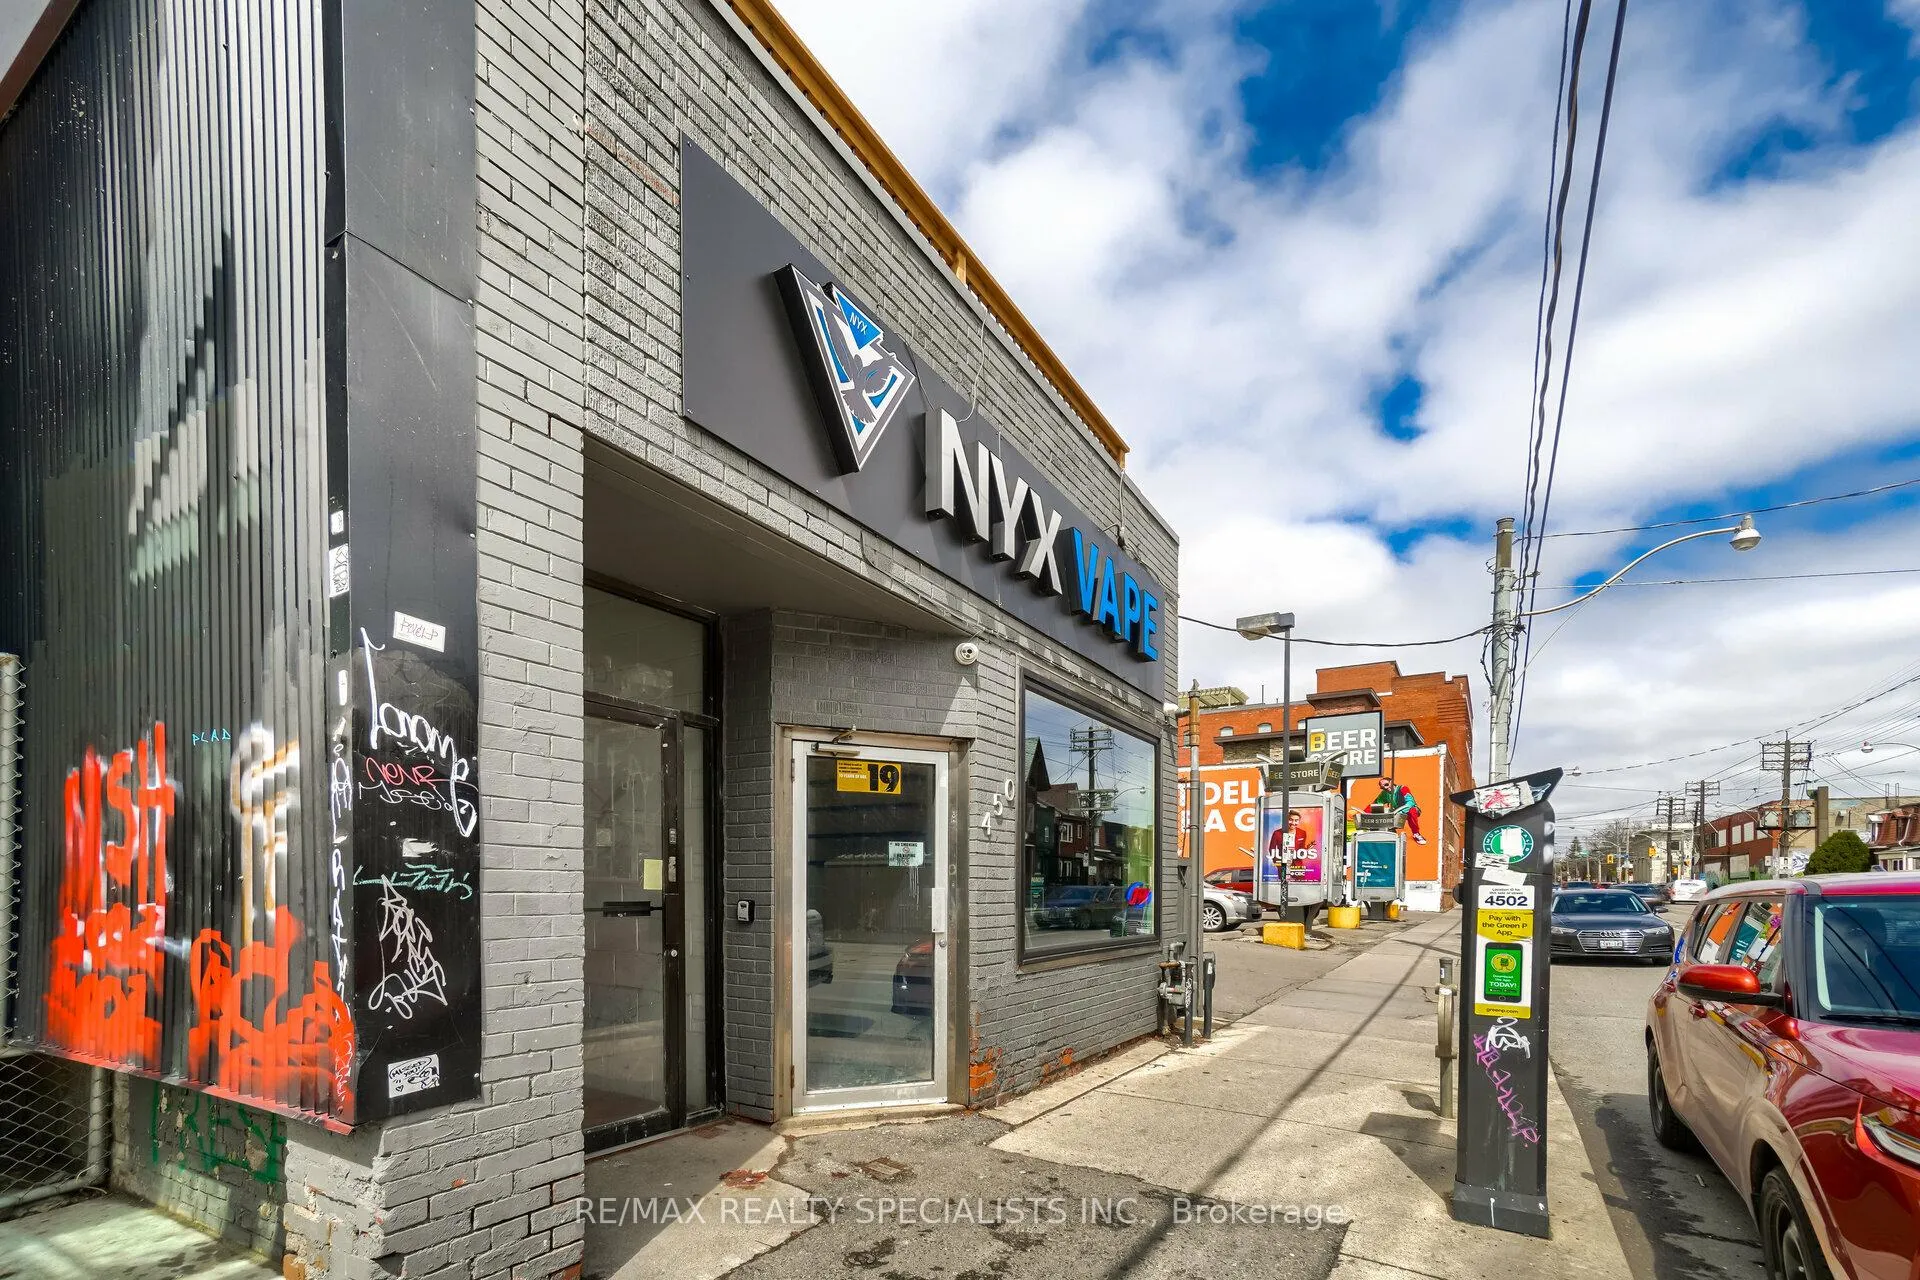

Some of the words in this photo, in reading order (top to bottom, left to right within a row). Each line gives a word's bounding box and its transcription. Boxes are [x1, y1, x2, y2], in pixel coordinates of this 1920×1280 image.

[848, 311, 868, 335] NYX
[926, 408, 1063, 596] NYX
[1062, 527, 1159, 662] VAPE
[1310, 728, 1377, 752] BEER
[1310, 749, 1377, 766] SRE
[868, 764, 899, 792] 19
[1269, 770, 1283, 780] BEE
[1291, 769, 1319, 778] STORE
[1485, 895, 1528, 907] 4502
[1489, 914, 1502, 922] Pay
